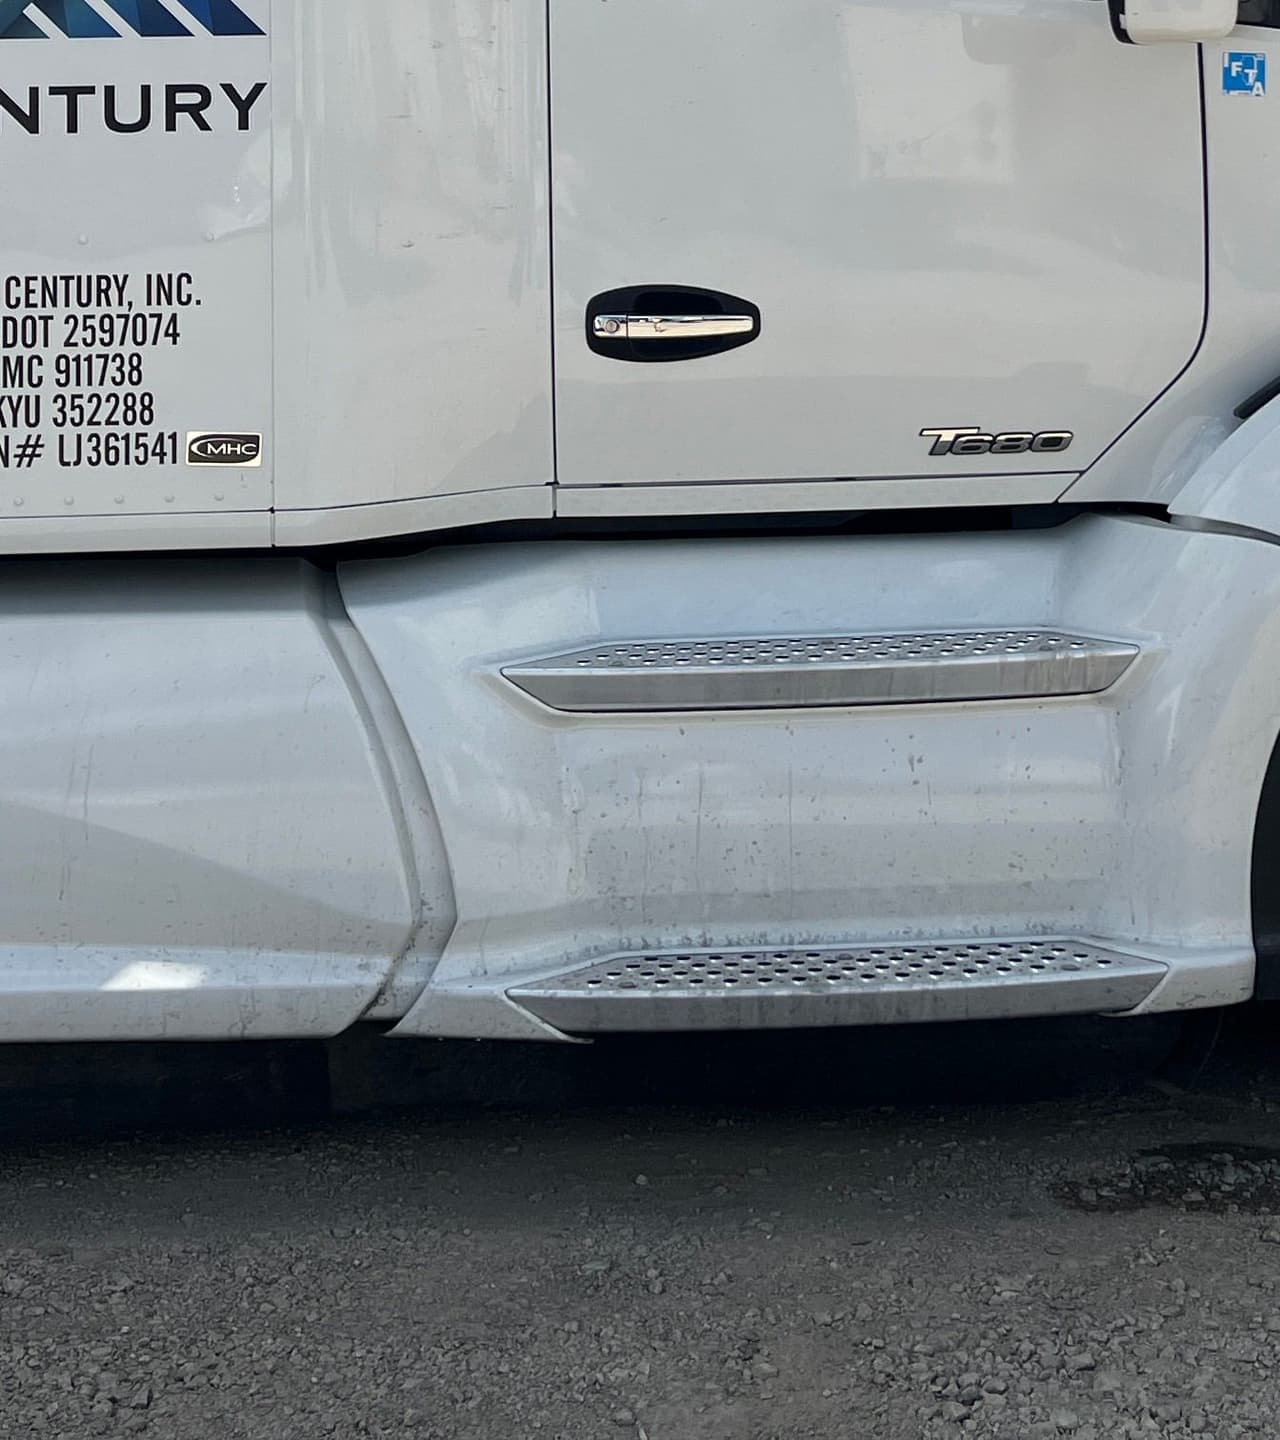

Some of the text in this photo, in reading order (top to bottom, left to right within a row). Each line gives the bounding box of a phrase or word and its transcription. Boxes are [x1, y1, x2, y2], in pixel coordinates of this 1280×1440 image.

[5, 273, 133, 313] CENTURY,
[146, 272, 202, 307] INC.
[63, 312, 181, 348] 2597074
[2, 352, 143, 389] MC 911738
[52, 391, 154, 428] 352288
[58, 431, 177, 467] LJ361541
[207, 443, 257, 455] MHC
[919, 426, 1074, 456] T680
